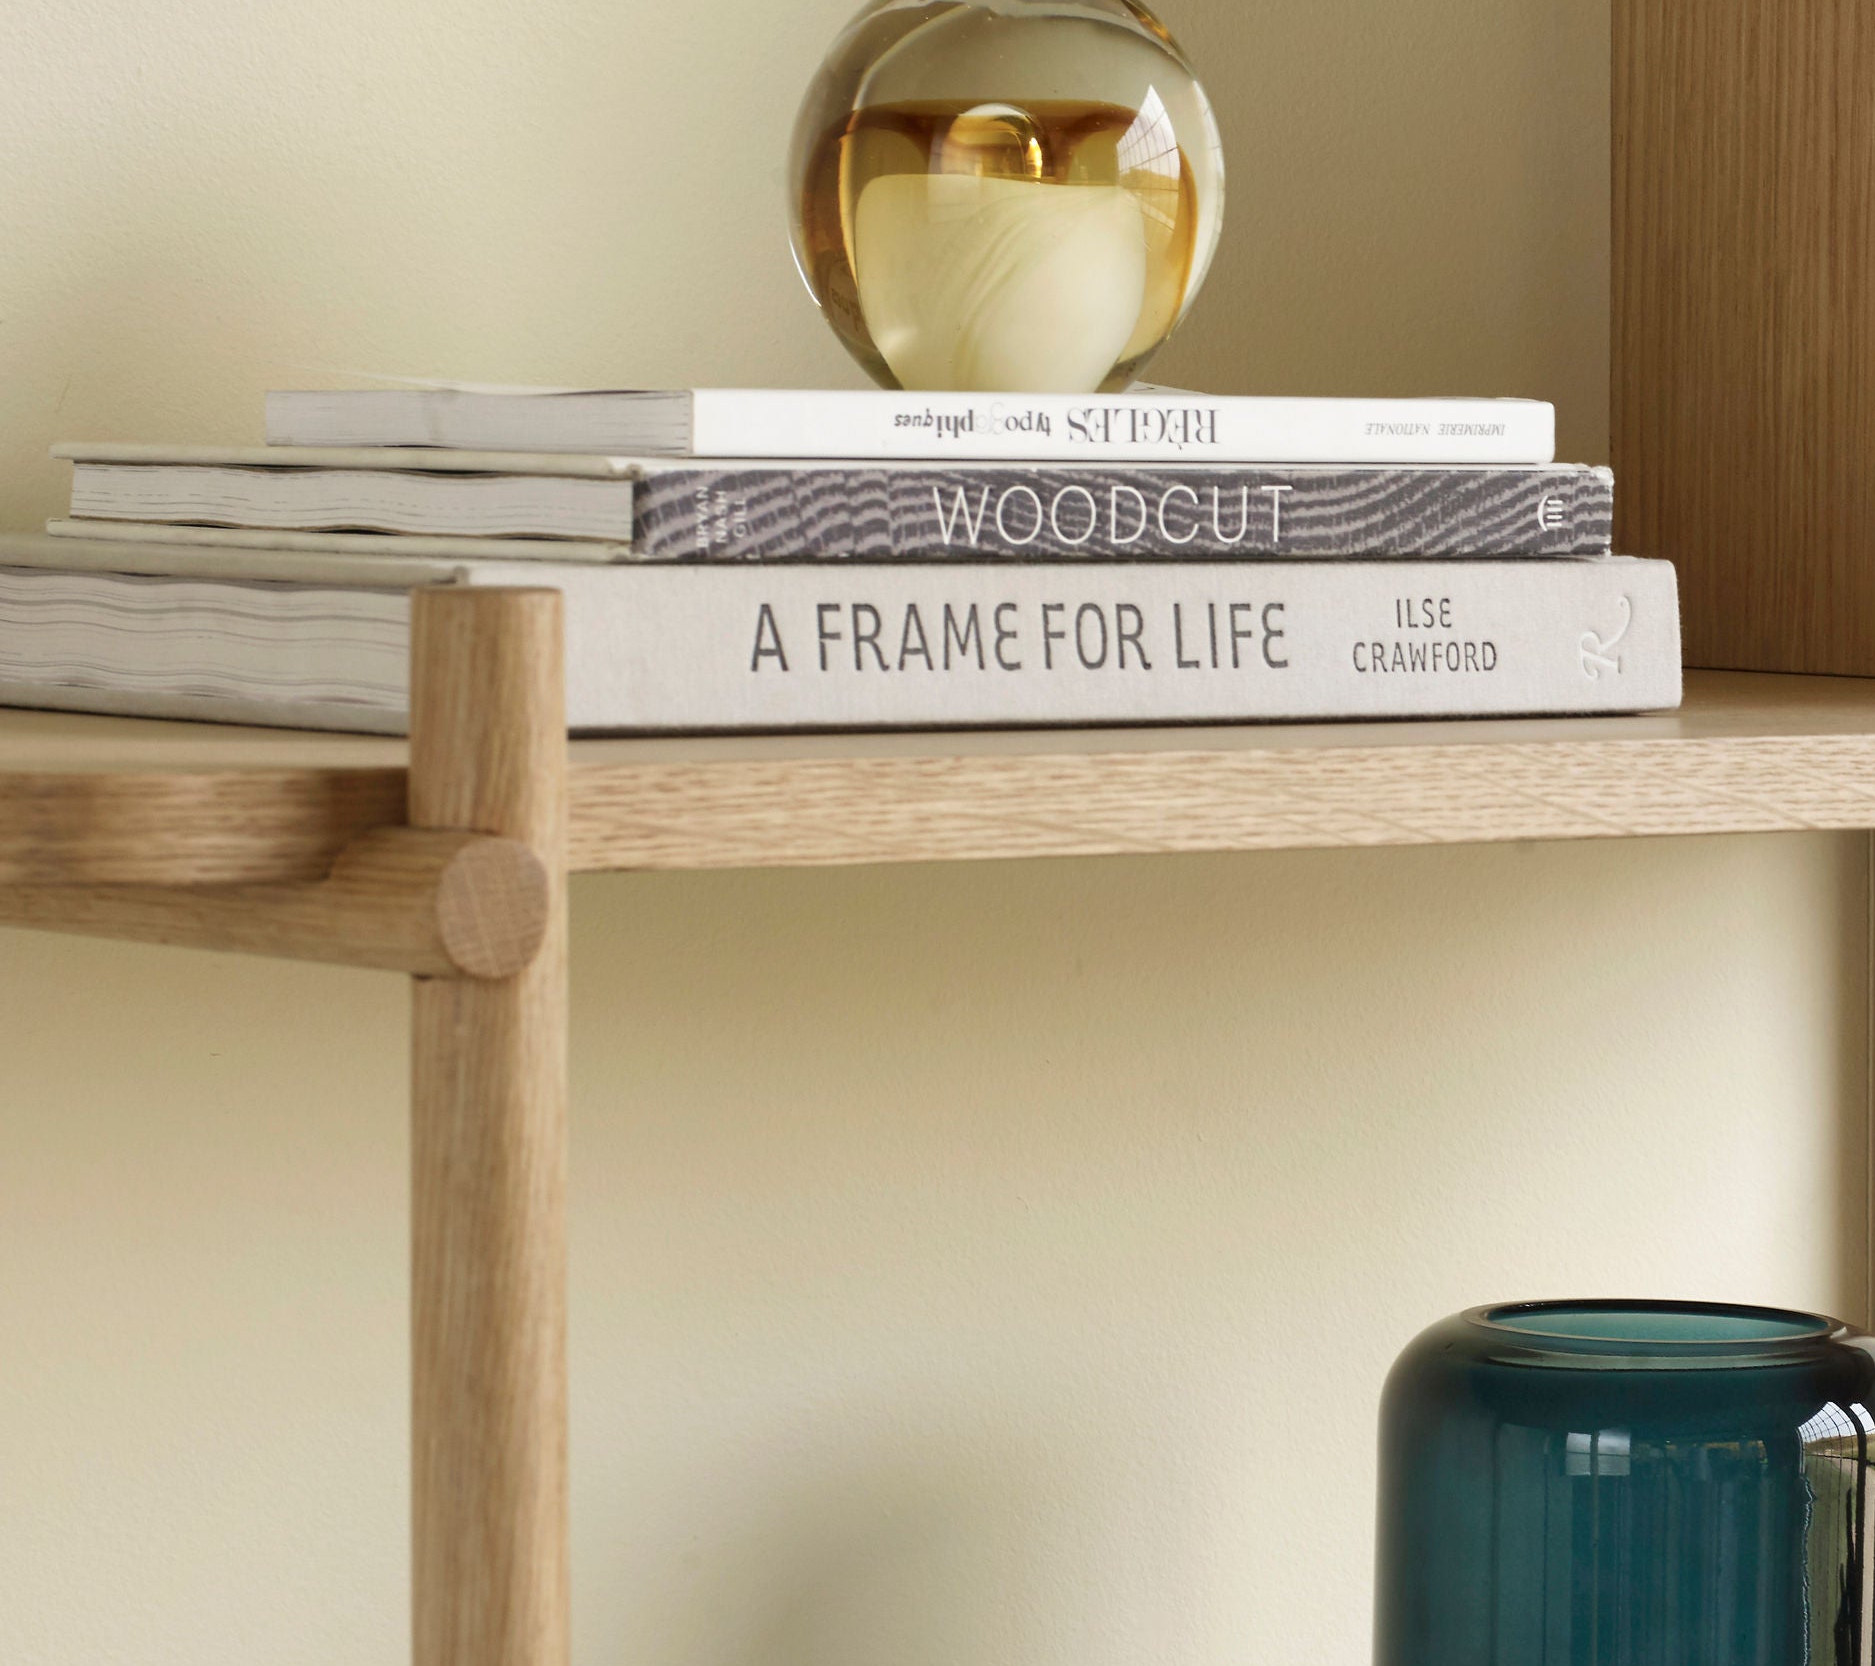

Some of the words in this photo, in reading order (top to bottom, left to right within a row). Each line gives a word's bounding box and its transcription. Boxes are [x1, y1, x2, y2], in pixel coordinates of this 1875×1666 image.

[1066, 407, 1222, 451] RÈGLES
[1365, 422, 1432, 436] NATIONALE
[1437, 422, 1507, 437] IMPRIMERIE
[695, 485, 710, 549] BRYAN
[714, 490, 728, 544] NASH
[732, 499, 748, 539] GILL
[932, 484, 1294, 547] WOODCUT
[1395, 597, 1453, 629] ILSE
[750, 602, 790, 673] A
[815, 602, 1022, 673] FRAME
[1041, 602, 1153, 672] FOR
[1172, 602, 1290, 671] LIFE
[1351, 640, 1498, 674] CRAWFORD
